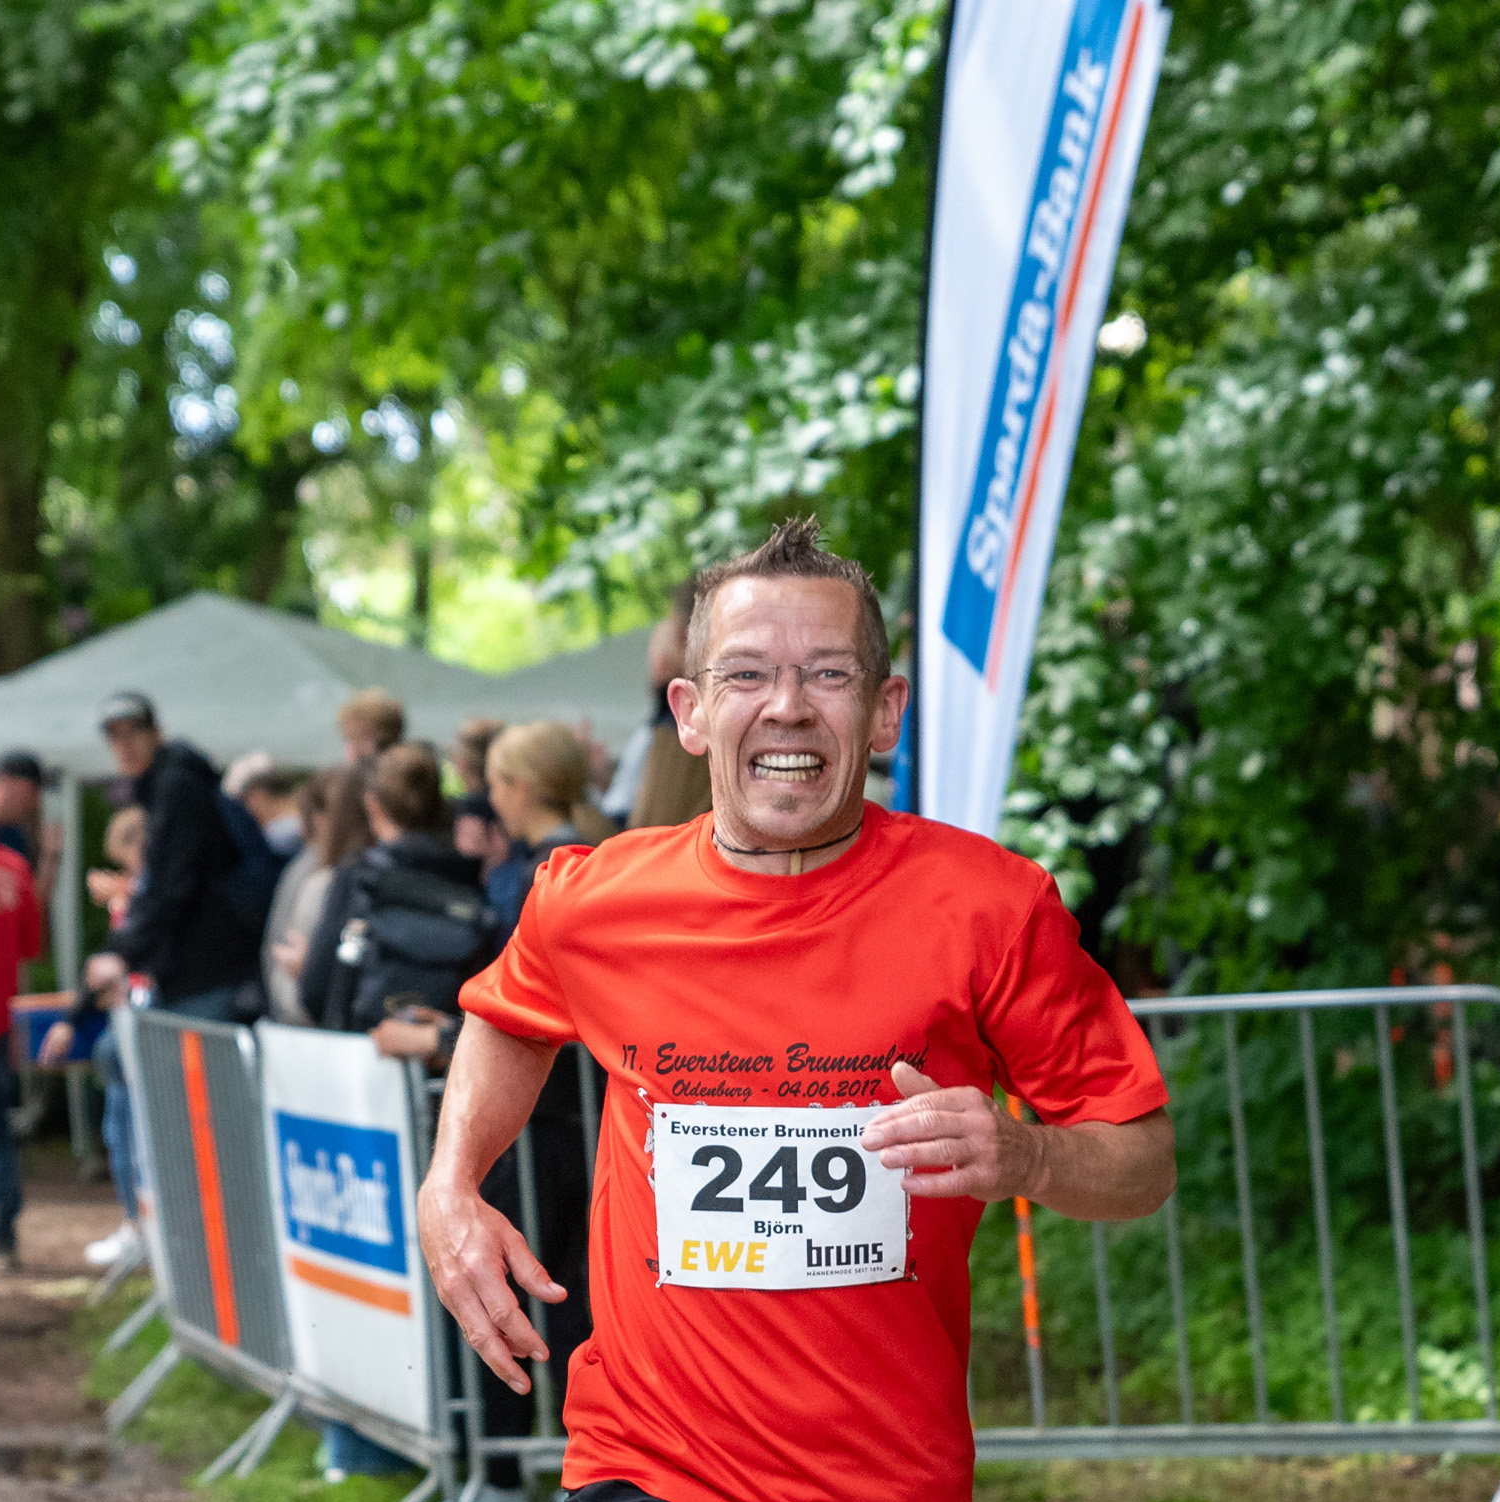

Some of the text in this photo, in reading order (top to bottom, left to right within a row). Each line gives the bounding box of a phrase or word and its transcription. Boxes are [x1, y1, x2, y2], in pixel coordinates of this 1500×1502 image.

[966, 47, 1104, 590] Sparda-Bank
[656, 1042, 775, 1074] Everstener
[672, 1079, 752, 1102] Oldenburg
[778, 1079, 881, 1097] 04.06.2017
[671, 1121, 768, 1137] Everstener
[691, 1144, 867, 1213] 249
[754, 1220, 803, 1237] Björn
[681, 1239, 768, 1273] EWE
[806, 1238, 883, 1267] bruns
[806, 1268, 852, 1276] MÄNNERMODE
